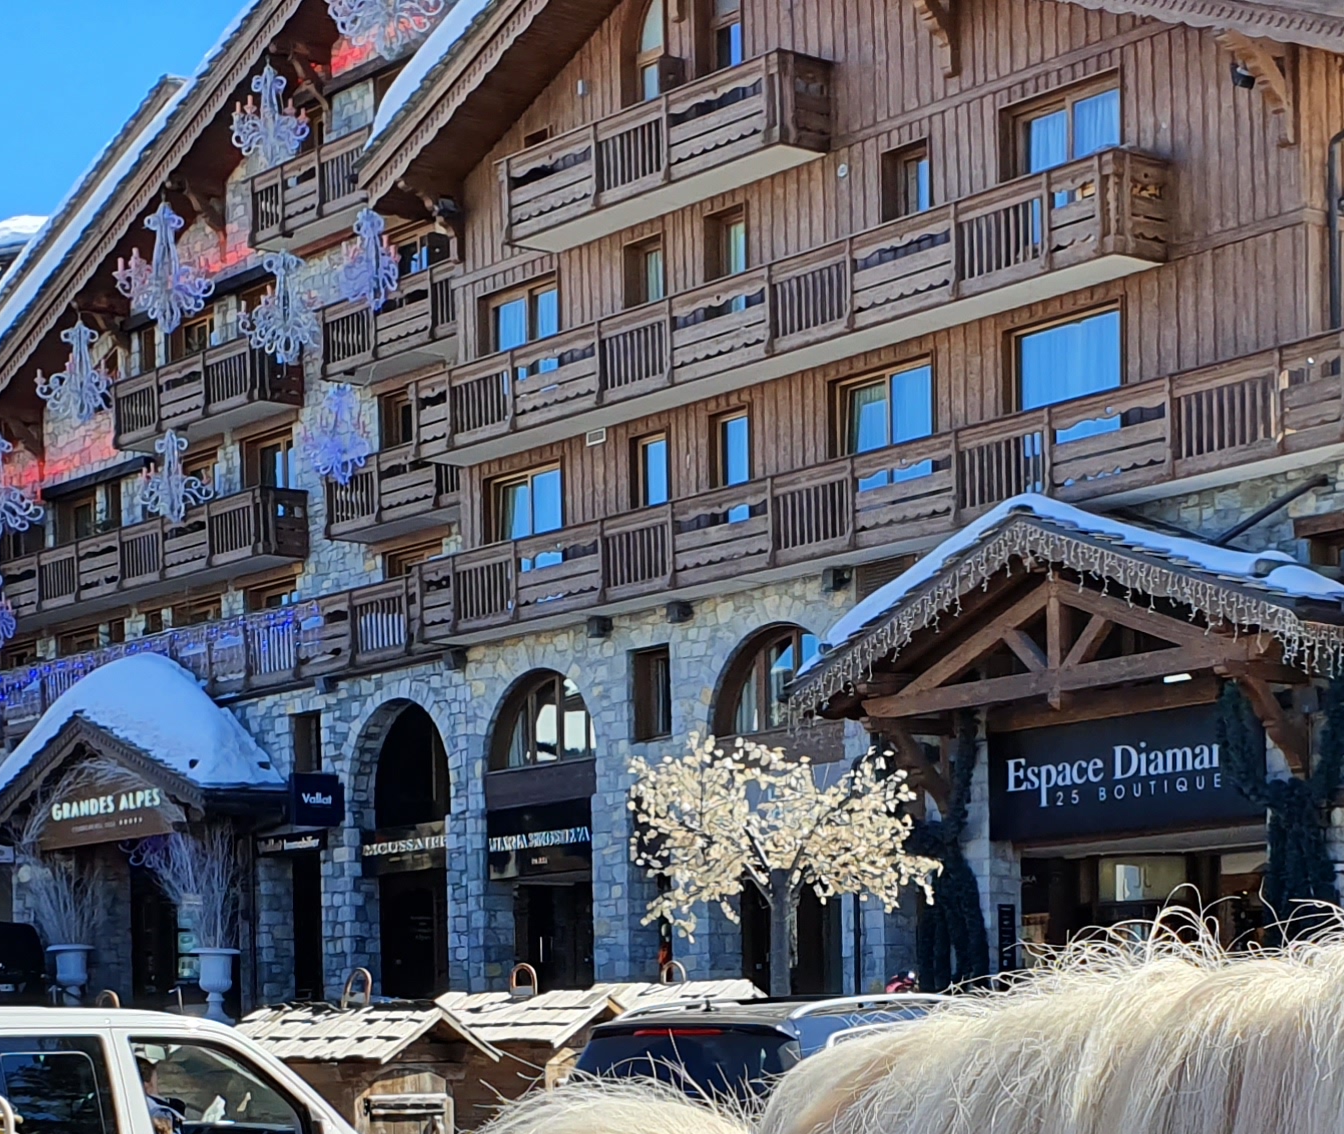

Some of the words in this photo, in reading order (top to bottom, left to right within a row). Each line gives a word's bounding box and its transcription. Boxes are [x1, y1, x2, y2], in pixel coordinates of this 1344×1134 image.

[1006, 757, 1105, 808] Espace
[51, 795, 115, 821] GRANDES
[119, 788, 161, 811] ALPES
[301, 791, 332, 805] Vallat
[1056, 789, 1080, 806] 25
